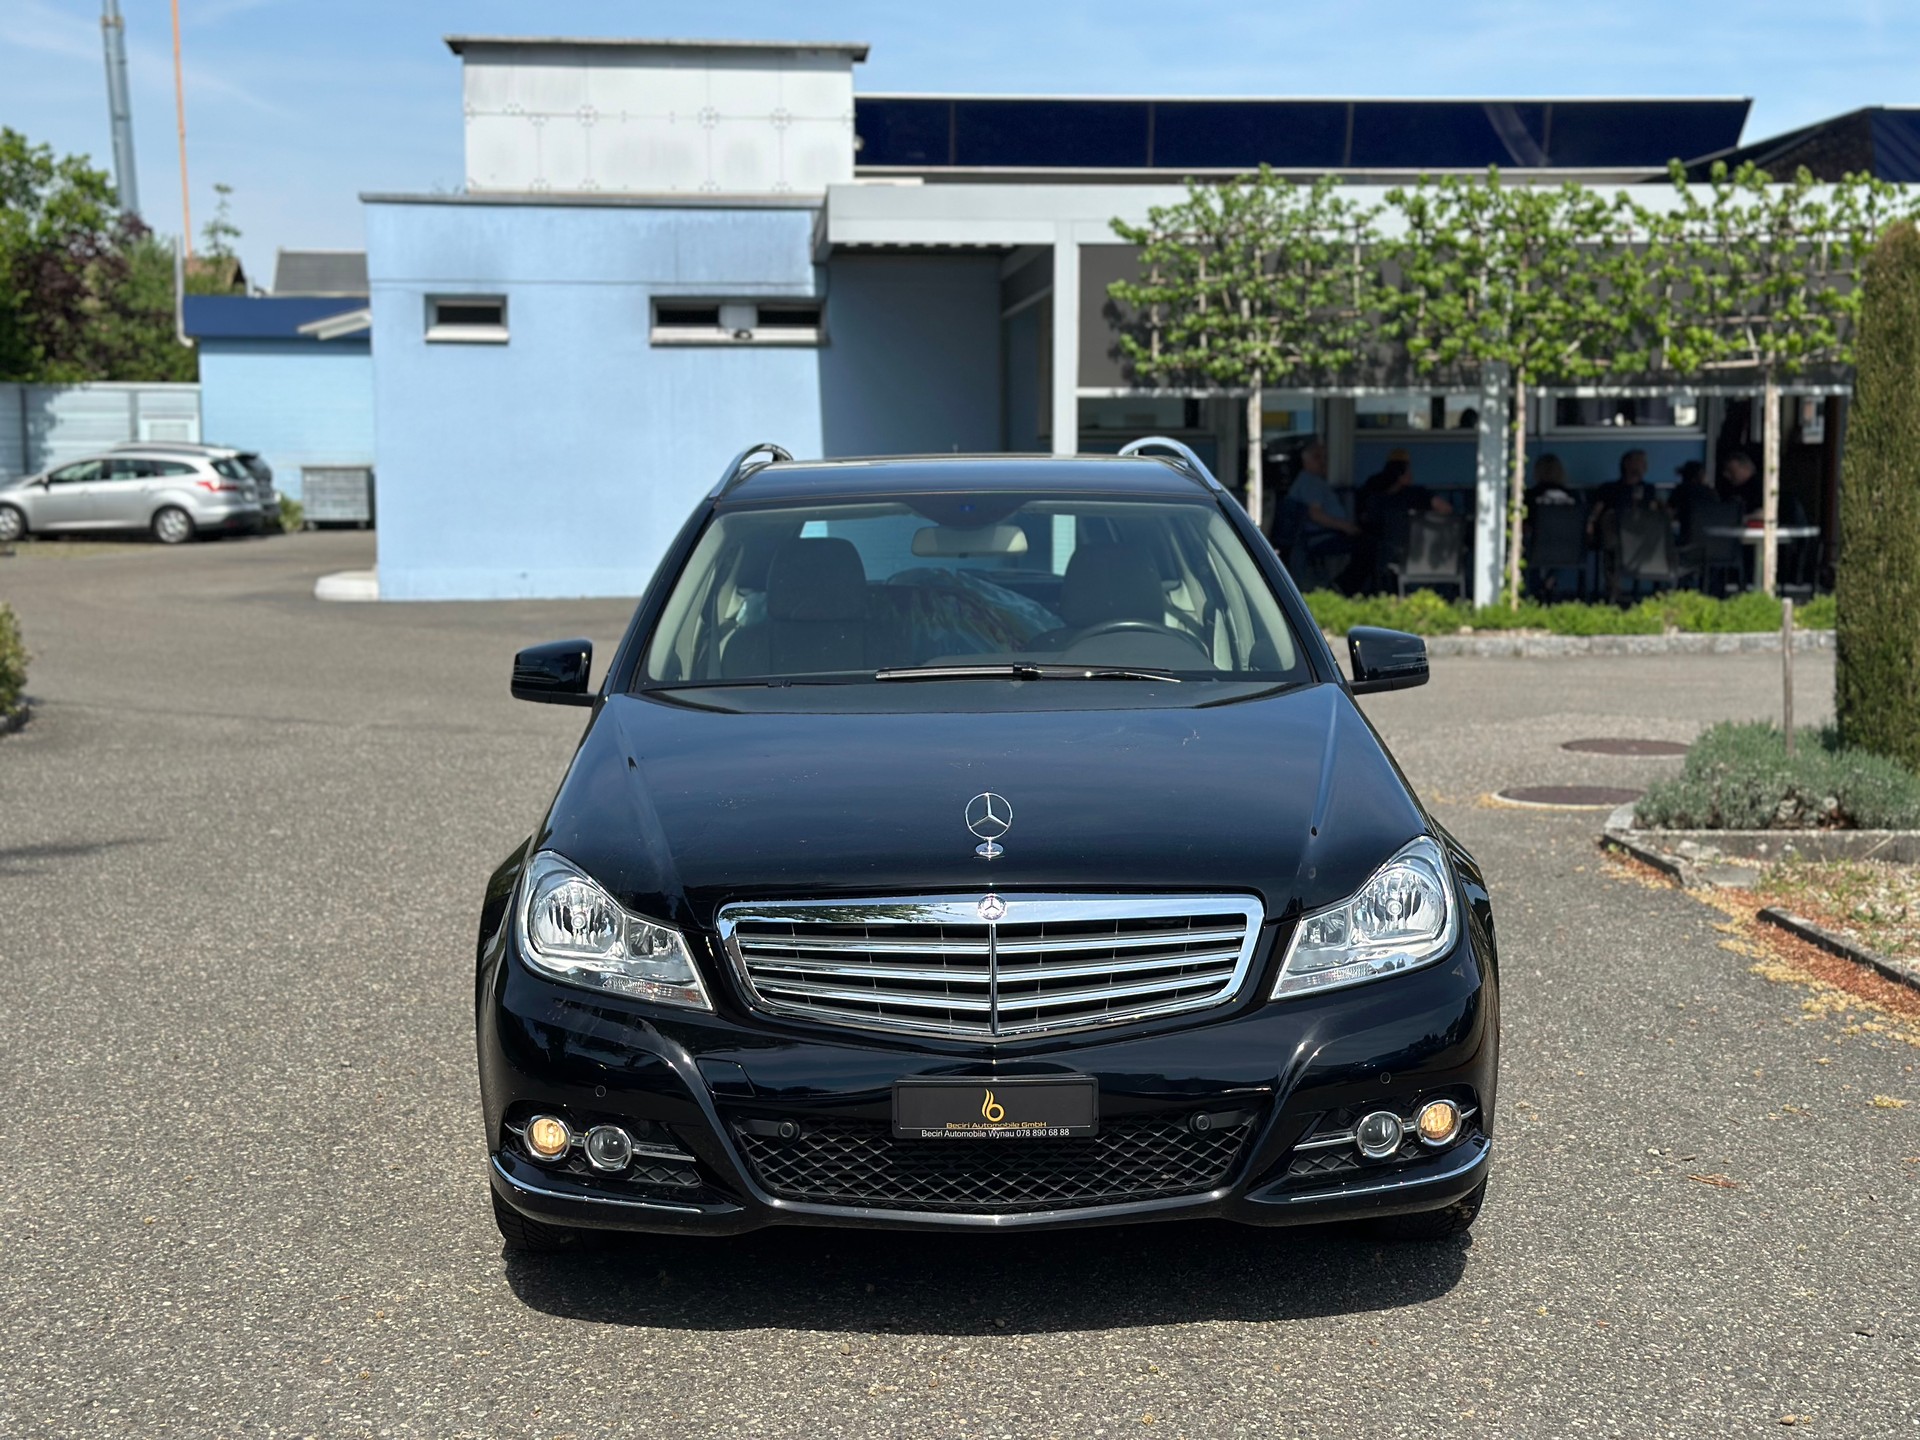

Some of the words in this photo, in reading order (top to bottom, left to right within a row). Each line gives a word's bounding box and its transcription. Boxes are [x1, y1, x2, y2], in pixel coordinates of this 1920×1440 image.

[943, 1129, 987, 1138] Automobile
[987, 1129, 1015, 1139] Wynau
[1016, 1129, 1031, 1137] 078
[1032, 1128, 1047, 1137] 890
[1048, 1128, 1058, 1137] 68
[1059, 1128, 1070, 1136] 88
